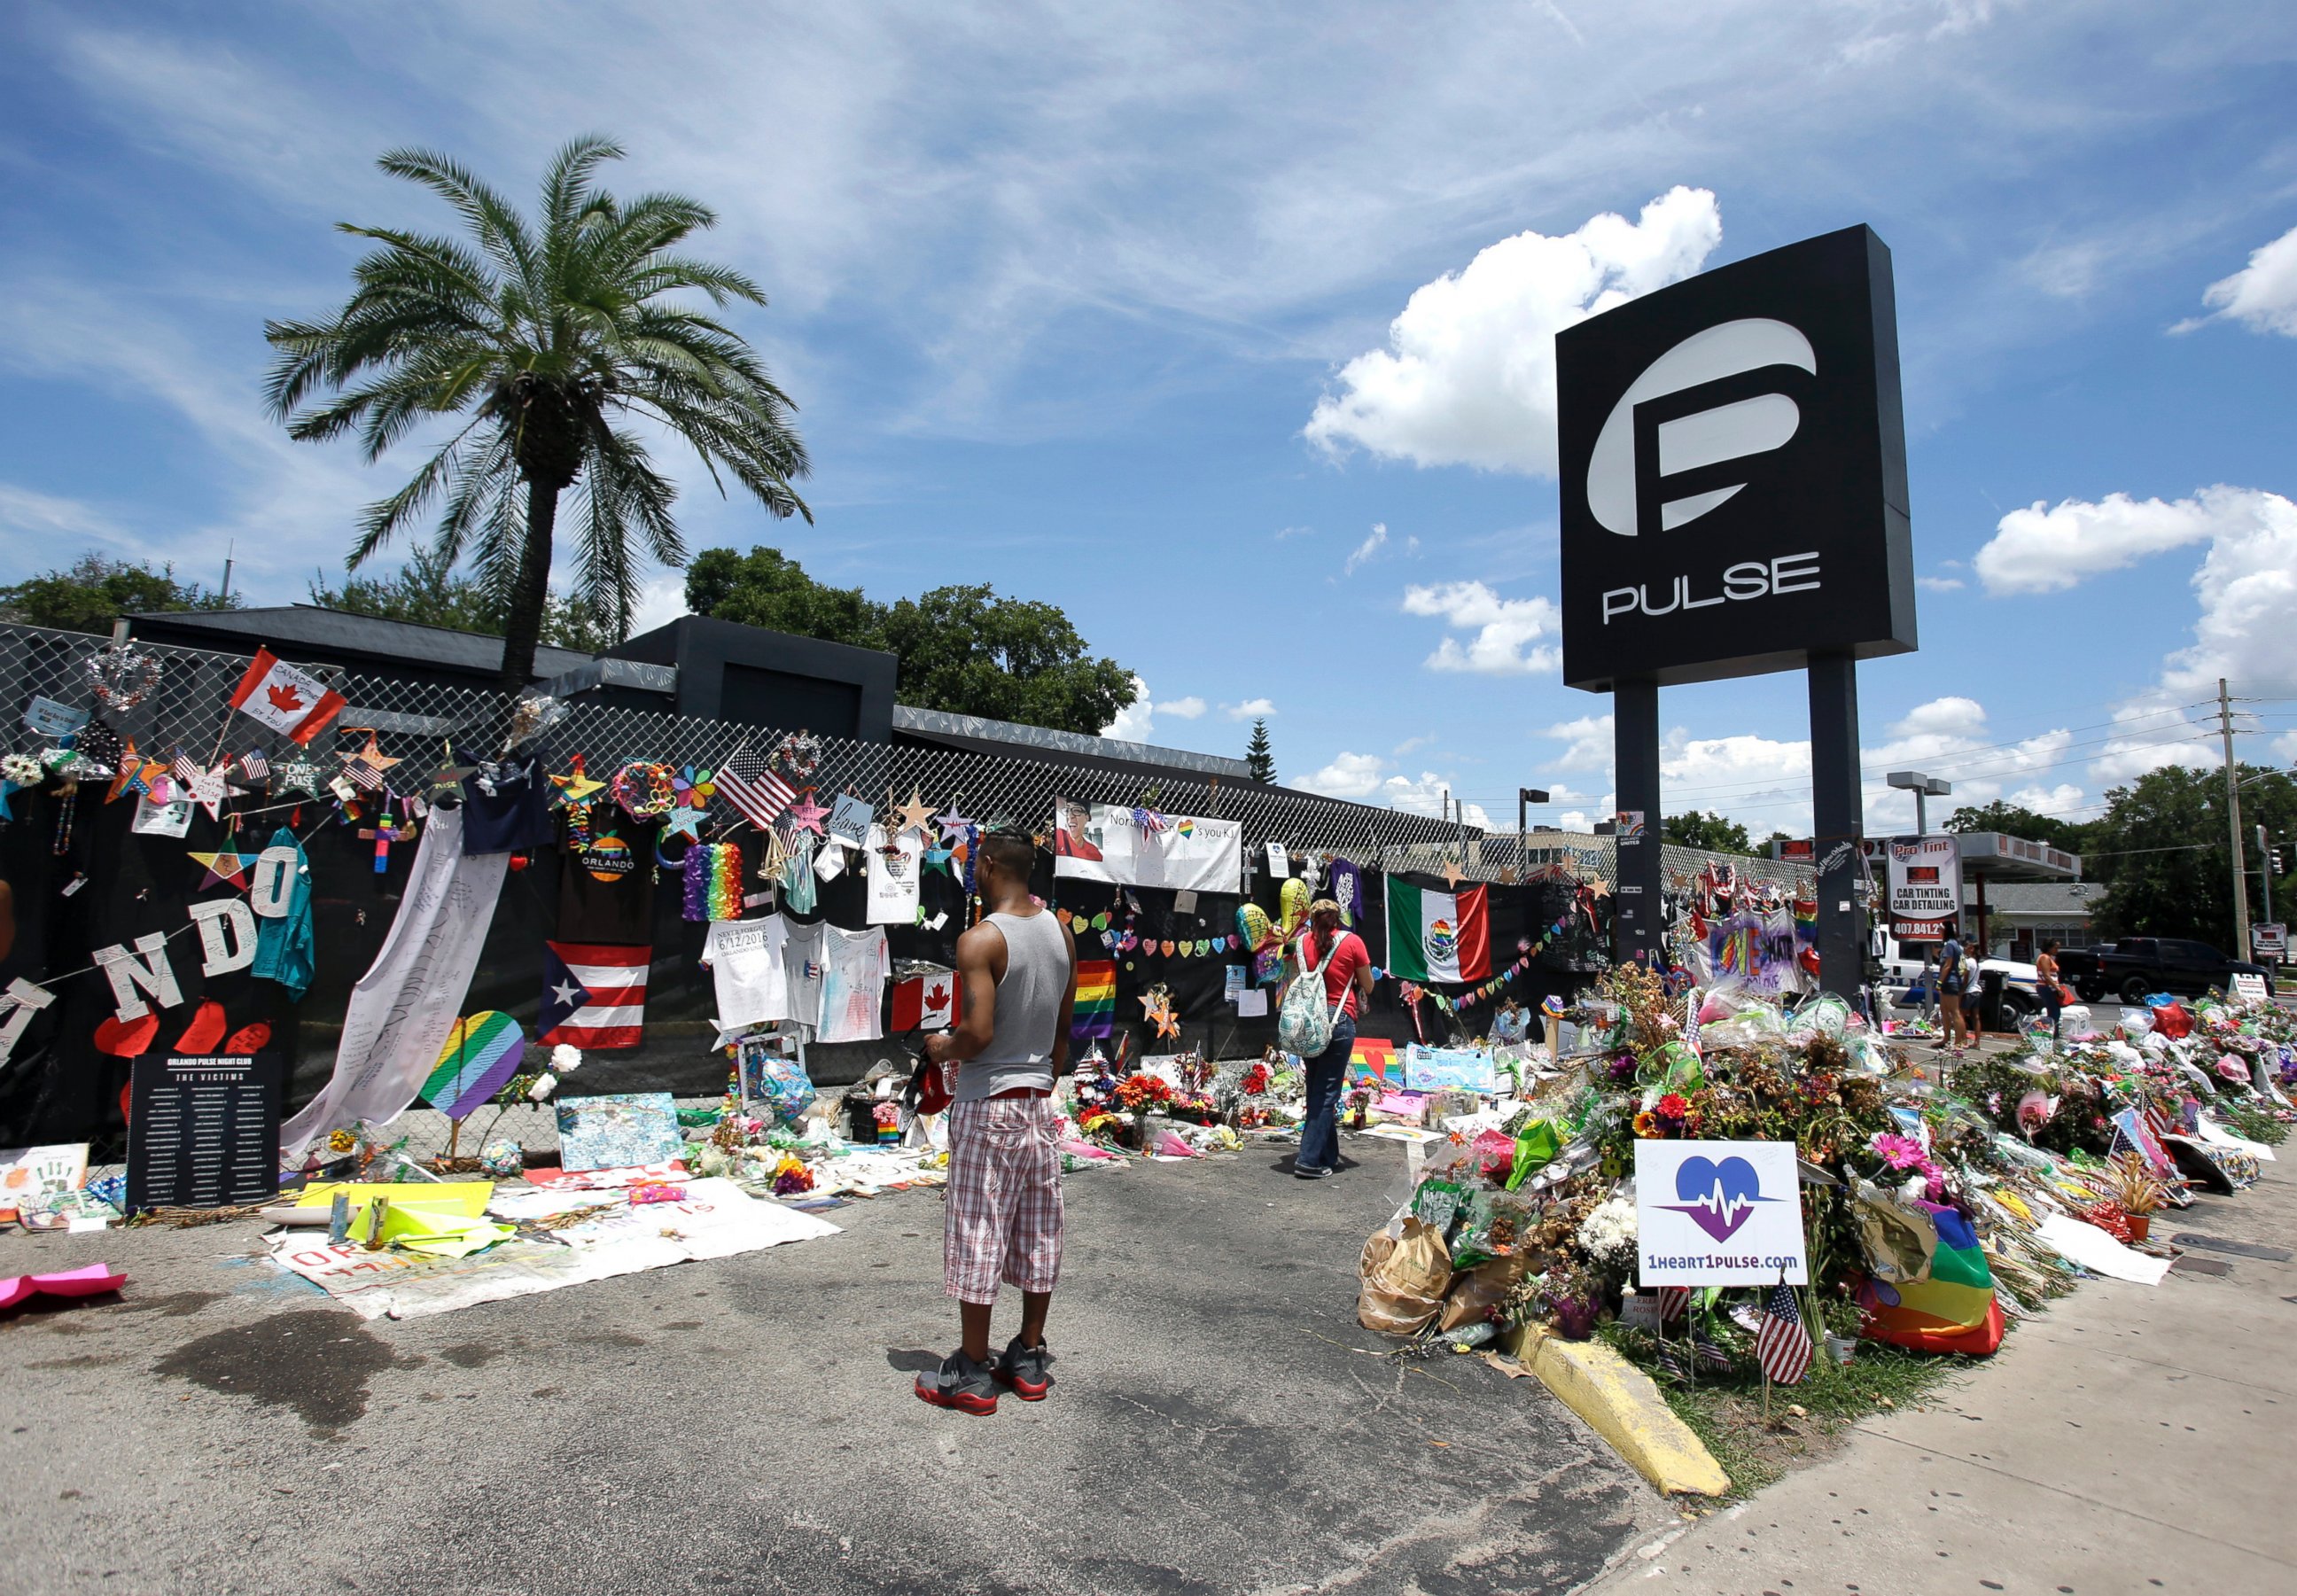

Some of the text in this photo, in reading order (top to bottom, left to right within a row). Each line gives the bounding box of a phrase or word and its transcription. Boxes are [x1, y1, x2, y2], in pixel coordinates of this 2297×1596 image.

[1603, 551, 1821, 626] PULSE
[274, 665, 312, 687] CANADA
[286, 764, 312, 775] ONE
[284, 775, 316, 787] PULSE
[197, 784, 221, 800] Pulse
[1204, 828, 1221, 839] you
[1785, 841, 1810, 854] 3M
[1895, 841, 1949, 857] Pro Tint
[1912, 868, 1936, 880] 3M
[1896, 888, 1950, 899] CAR TINTING
[1892, 899, 1955, 910] CAR DETAILING
[717, 924, 767, 938] NEVER FORGET
[719, 931, 768, 950] 6/12/2016
[721, 946, 749, 957] ORLANDO
[200, 1072, 244, 1081] VICTIMS
